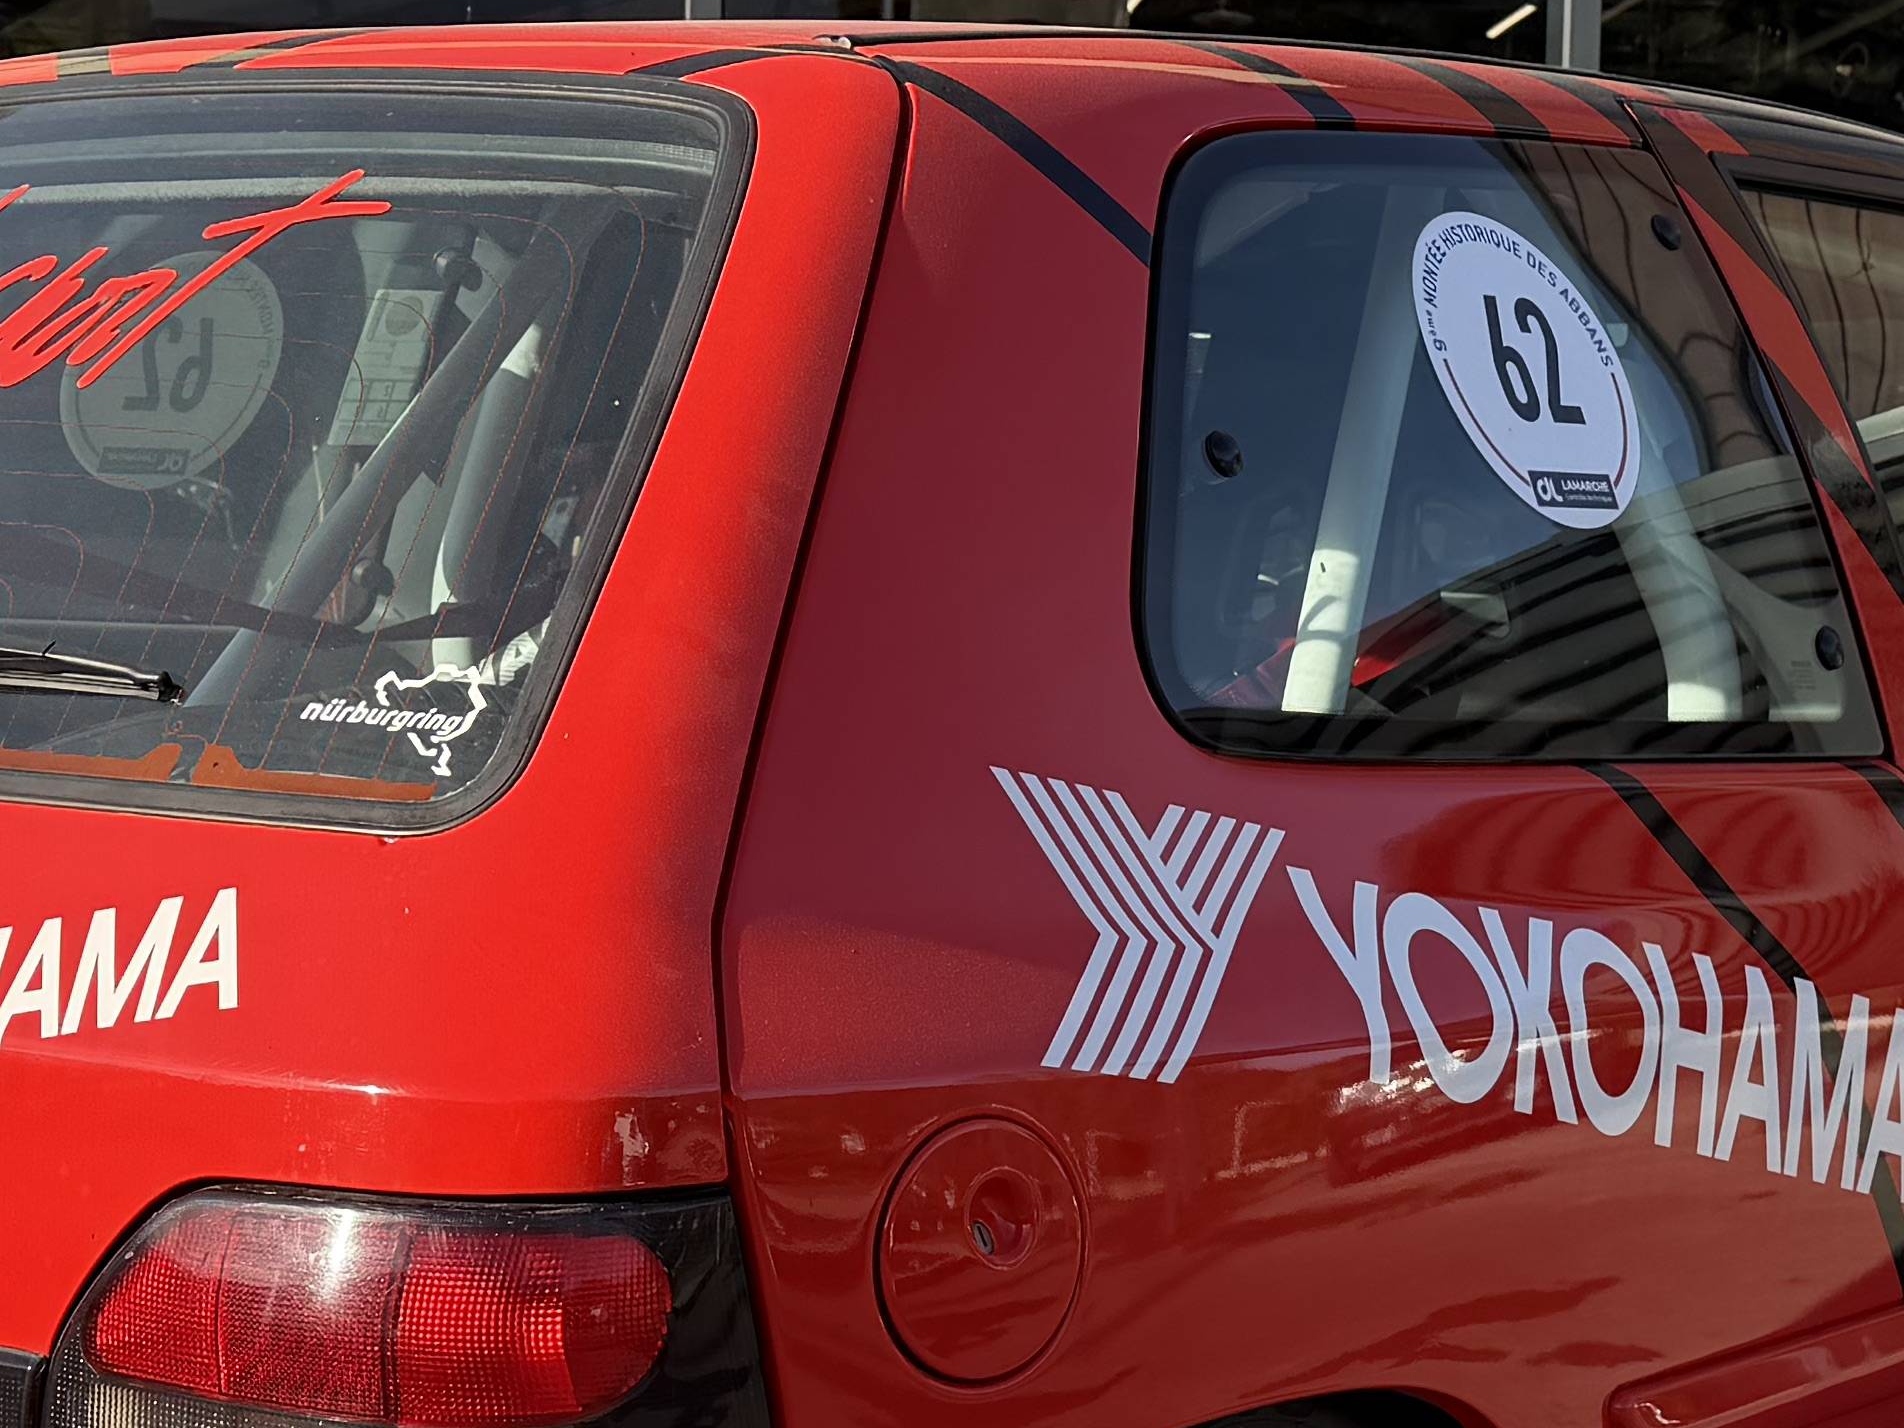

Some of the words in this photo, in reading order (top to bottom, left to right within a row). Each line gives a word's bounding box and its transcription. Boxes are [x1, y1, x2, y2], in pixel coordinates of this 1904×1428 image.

[1422, 239, 1447, 309] MONTÉE
[1438, 223, 1522, 260] HISTORIQUE
[1526, 250, 1558, 288] DES
[1559, 287, 1614, 367] ABBANS
[1483, 294, 1587, 425] 62
[1561, 479, 1610, 493] LAMARCHE
[300, 698, 467, 733] nürburgring
